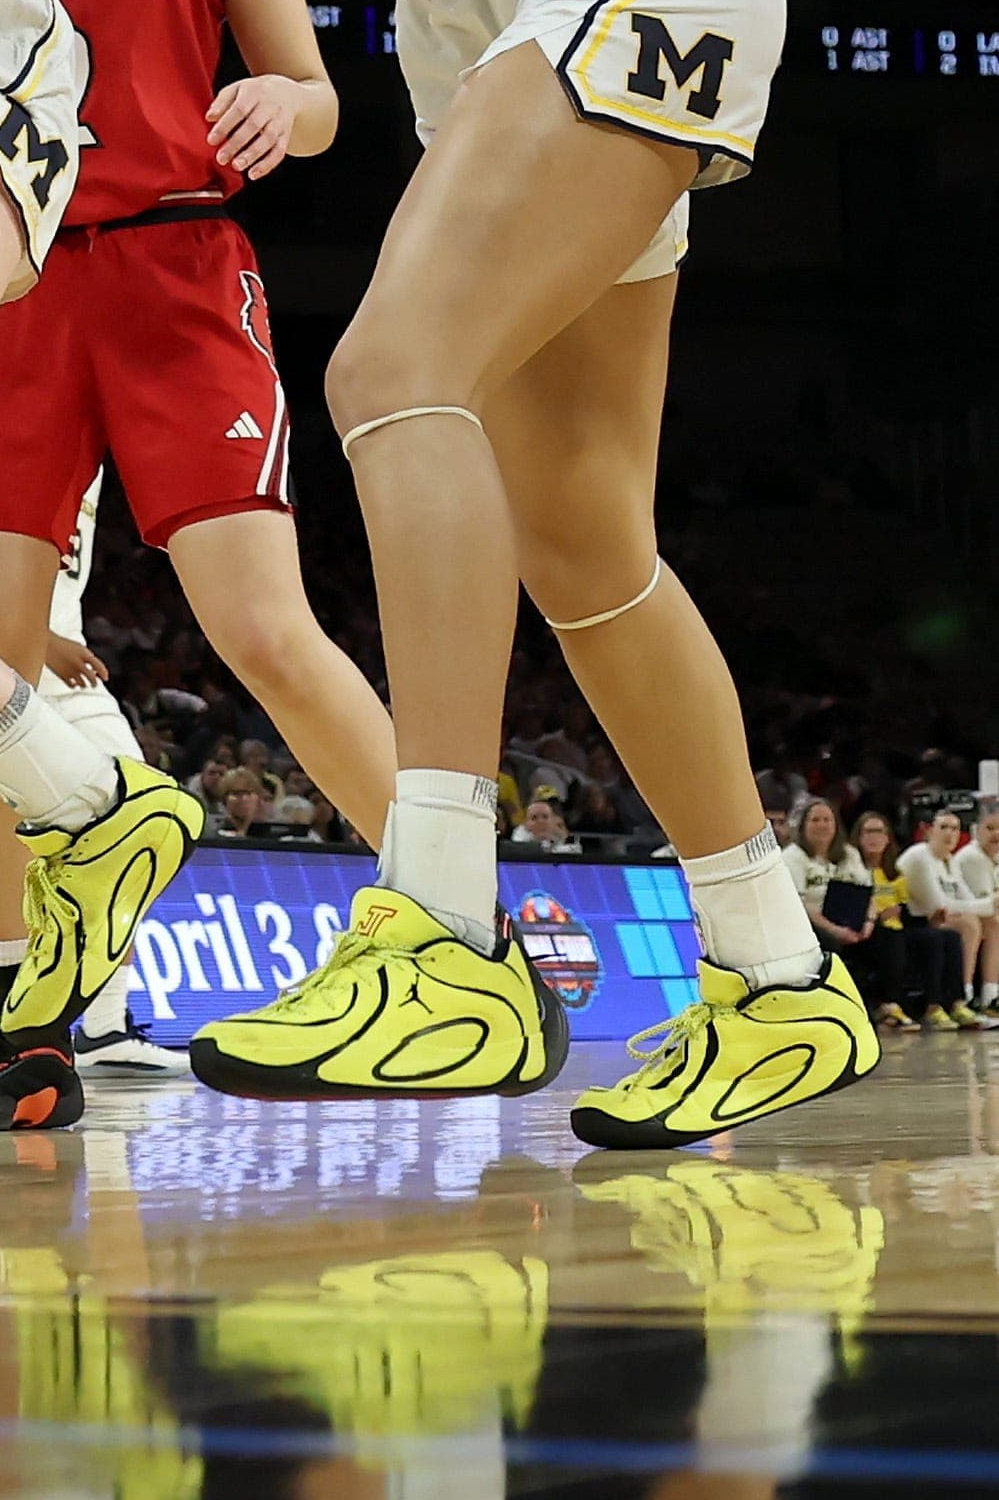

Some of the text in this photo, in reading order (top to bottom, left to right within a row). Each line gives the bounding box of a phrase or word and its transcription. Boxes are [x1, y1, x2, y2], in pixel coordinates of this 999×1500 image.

[627, 11, 735, 121] M
[127, 893, 263, 1019] pril
[254, 902, 307, 989] 3
